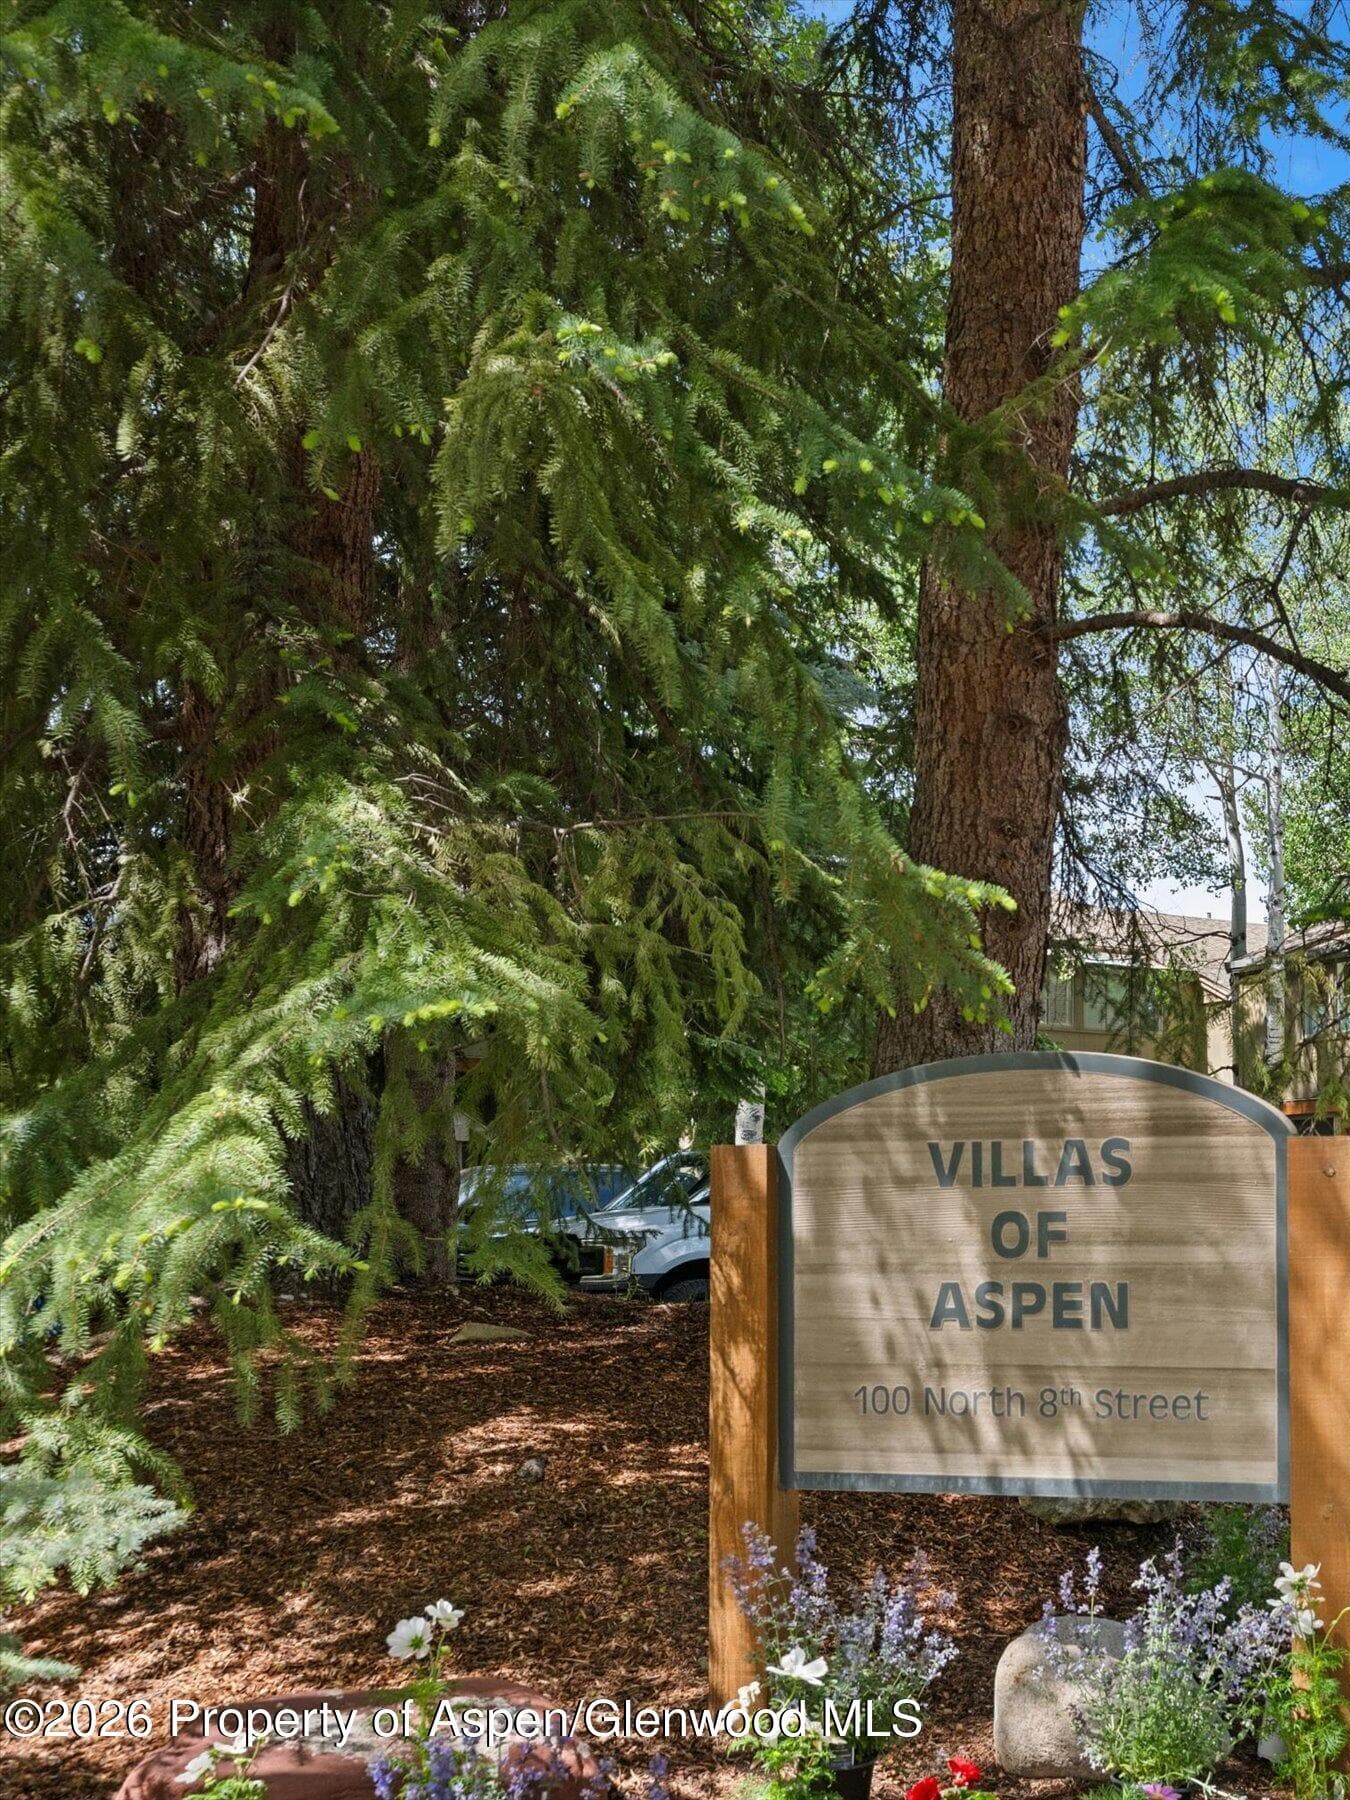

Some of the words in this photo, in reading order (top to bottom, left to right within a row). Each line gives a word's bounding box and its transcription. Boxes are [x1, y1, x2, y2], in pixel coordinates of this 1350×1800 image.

[928, 1138, 1132, 1187] VILLAS
[991, 1211, 1068, 1258] OF
[929, 1281, 1130, 1330] ASPEN
[854, 1384, 911, 1415] 100
[924, 1385, 1025, 1418] North
[1039, 1387, 1082, 1419] 8th
[1095, 1388, 1209, 1421] Street
